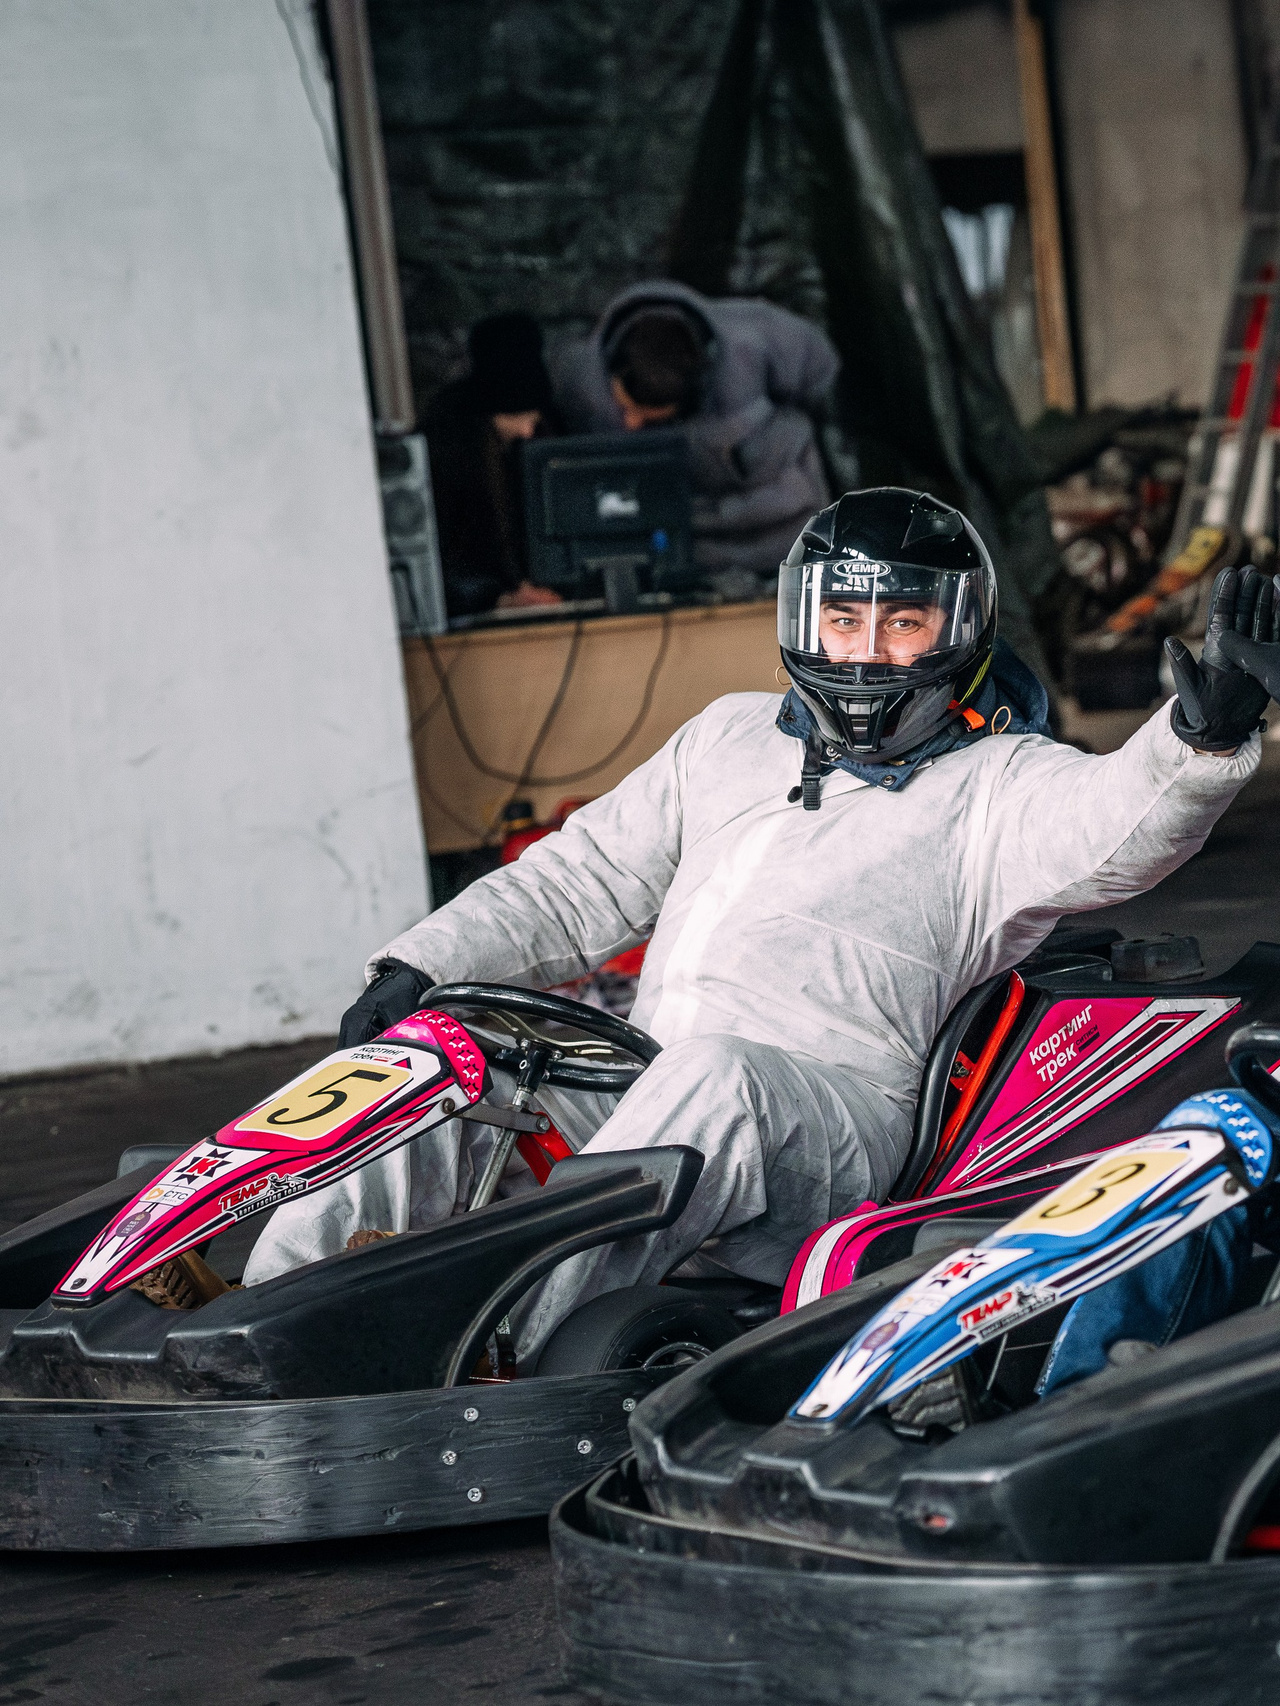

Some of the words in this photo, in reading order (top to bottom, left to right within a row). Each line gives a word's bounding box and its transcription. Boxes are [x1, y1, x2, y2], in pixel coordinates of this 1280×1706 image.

[1028, 1003, 1093, 1066] картинг
[1036, 1042, 1078, 1082] трек
[266, 1069, 392, 1125] 5
[1039, 1163, 1147, 1220] 3
